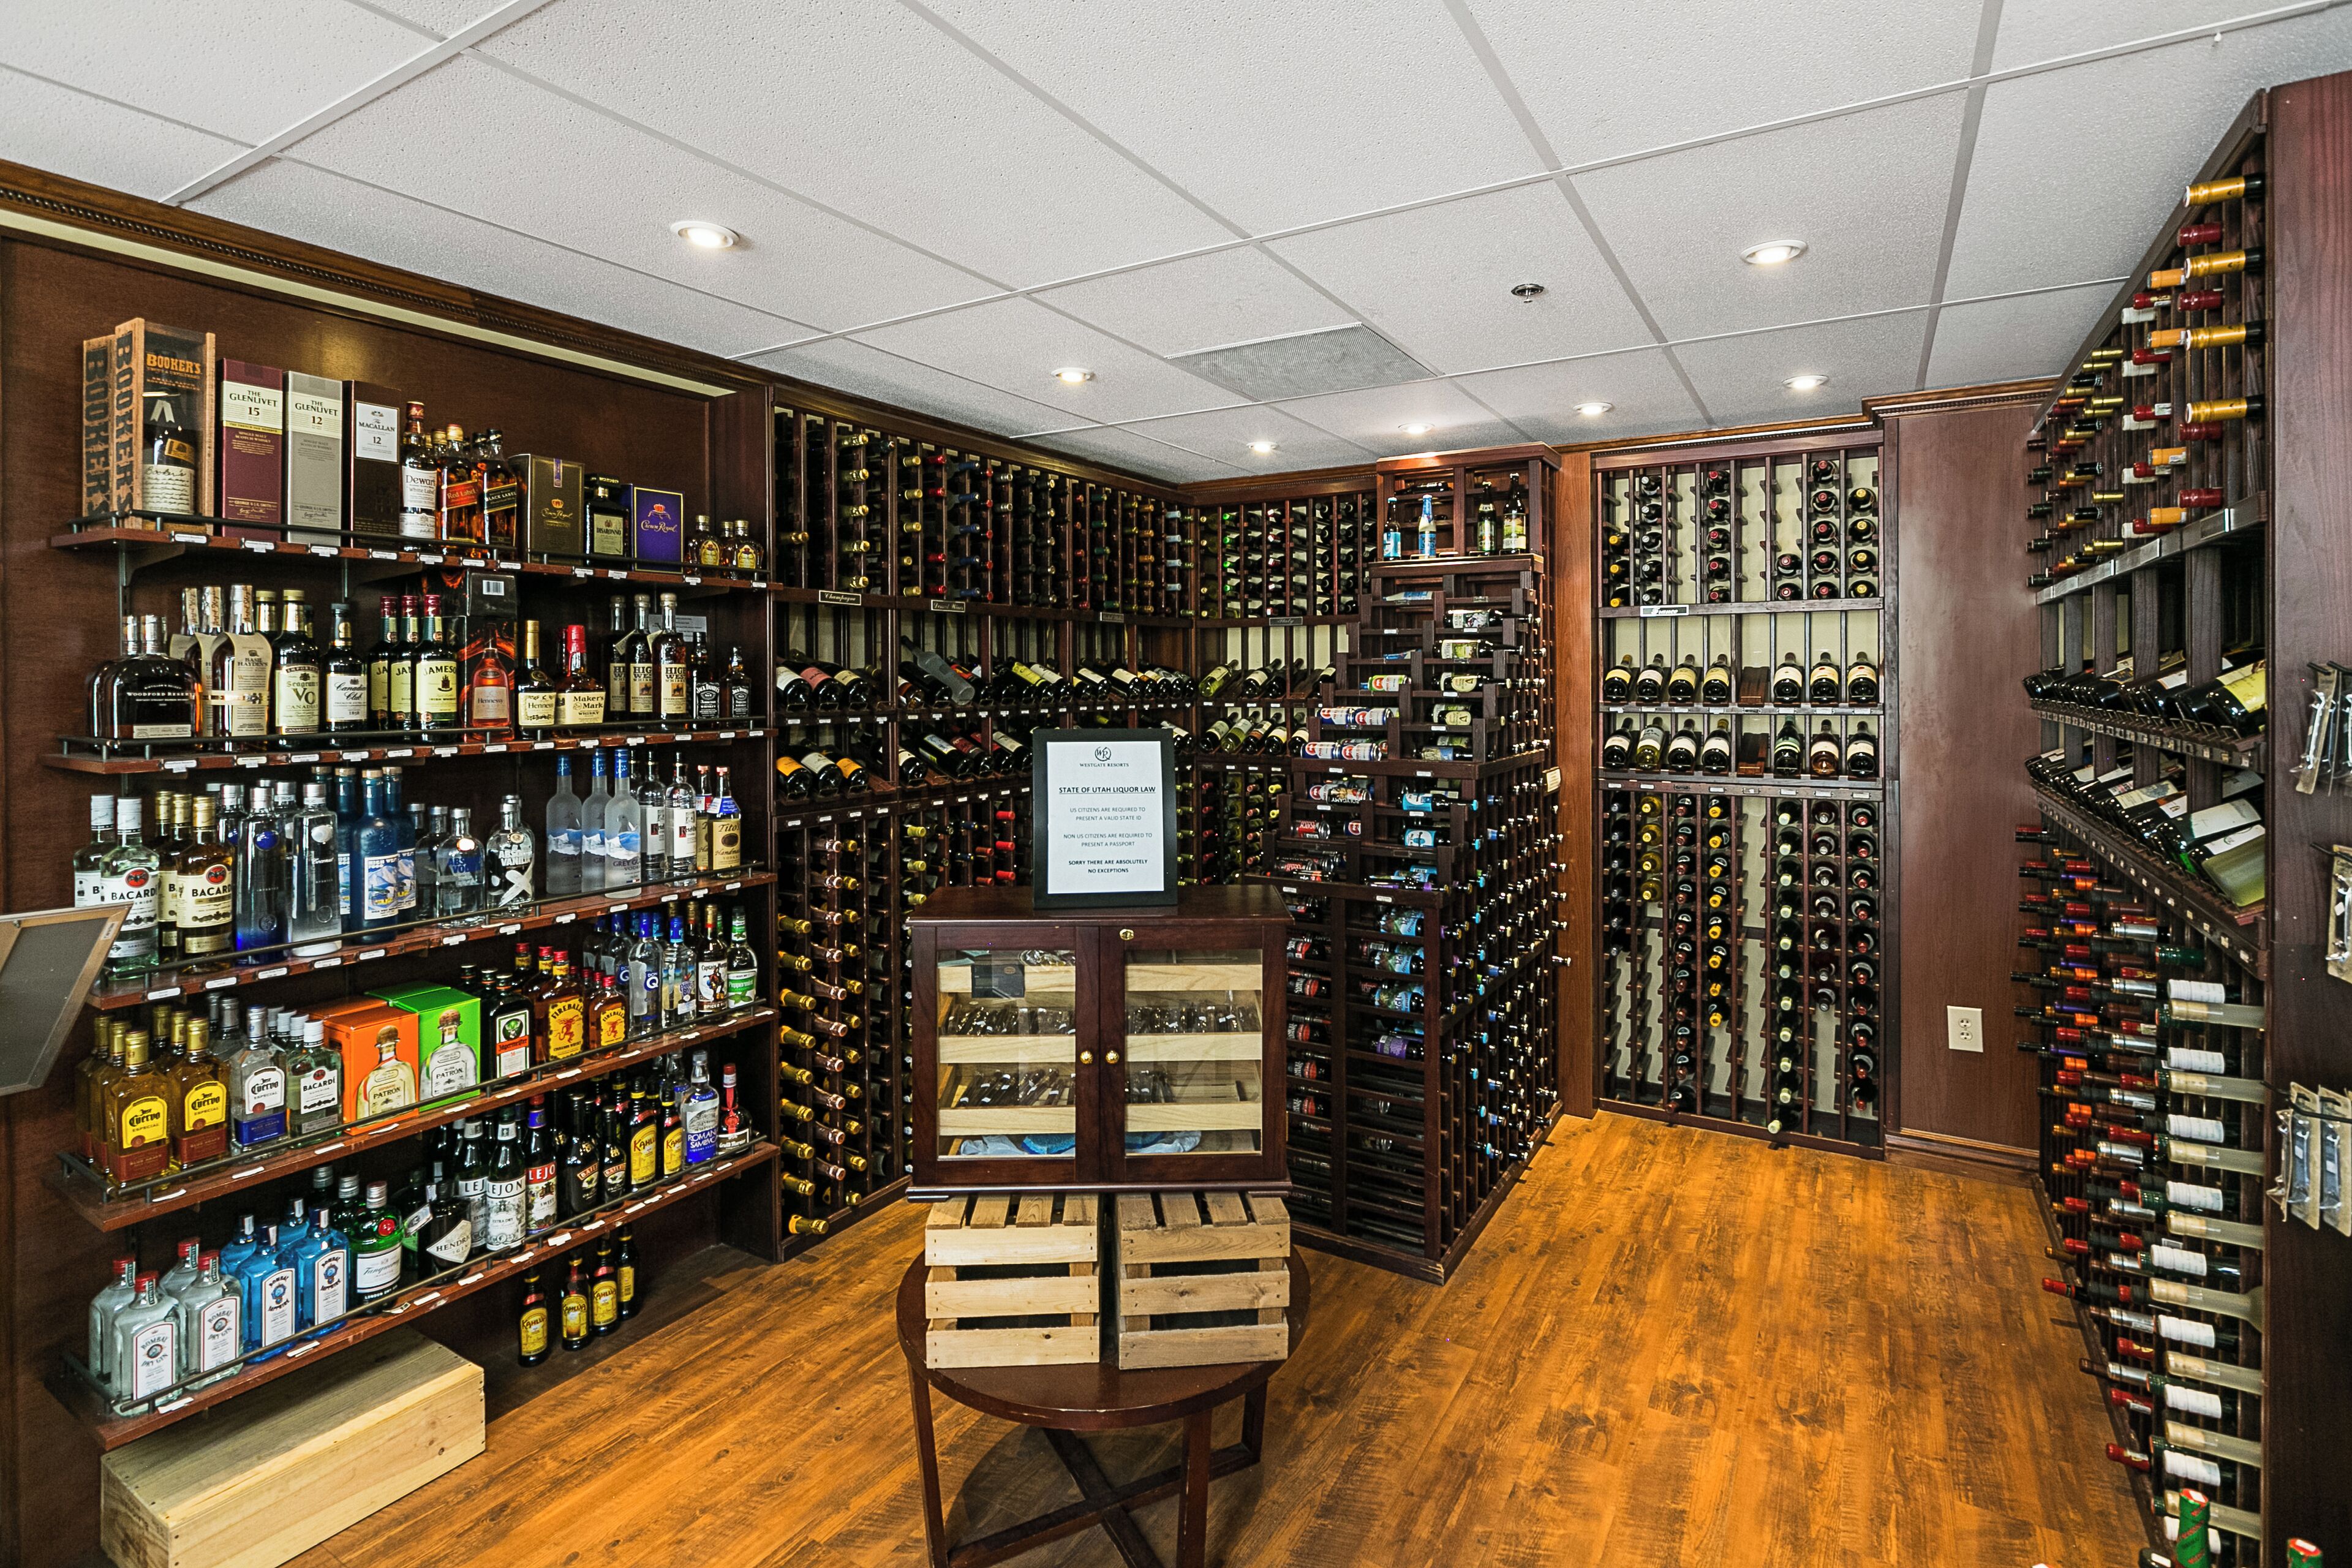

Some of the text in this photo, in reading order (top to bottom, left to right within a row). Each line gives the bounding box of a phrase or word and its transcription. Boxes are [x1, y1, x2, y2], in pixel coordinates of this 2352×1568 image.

[146, 353, 202, 375] BOOKER'S
[229, 393, 278, 407] GLENLIVET
[248, 407, 260, 417] 15
[295, 402, 338, 417] GLENLIVET
[311, 416, 323, 425] 12
[358, 421, 396, 432] MACALLAN
[461, 488, 477, 497] Label
[596, 527, 622, 536] DISARONNO
[641, 519, 678, 533] Crown Royal
[824, 592, 856, 603] Champagne
[696, 684, 706, 694] JACK
[344, 691, 363, 703] Club
[646, 977, 659, 989] Q
[551, 1003, 583, 1019] FIREBALL
[603, 1011, 625, 1022] FIREBALL
[251, 1081, 279, 1095] Cuervo
[303, 1076, 336, 1092] BACARDÍ
[254, 1091, 278, 1100] ESPECIAL
[191, 1096, 221, 1110] Cuervo
[194, 1107, 220, 1116] ESPECIAL
[129, 1112, 160, 1127] Cuervo
[132, 1123, 159, 1133] ESPECIAL
[529, 1164, 556, 1182] LEJO
[465, 1179, 486, 1193] LEJ
[321, 1256, 341, 1267] BOMBAY
[269, 1275, 290, 1287] BOMBAY
[208, 1308, 233, 1324] BOMBAY
[141, 1335, 169, 1350] BOMBAY
[156, 1352, 169, 1363] GIN
